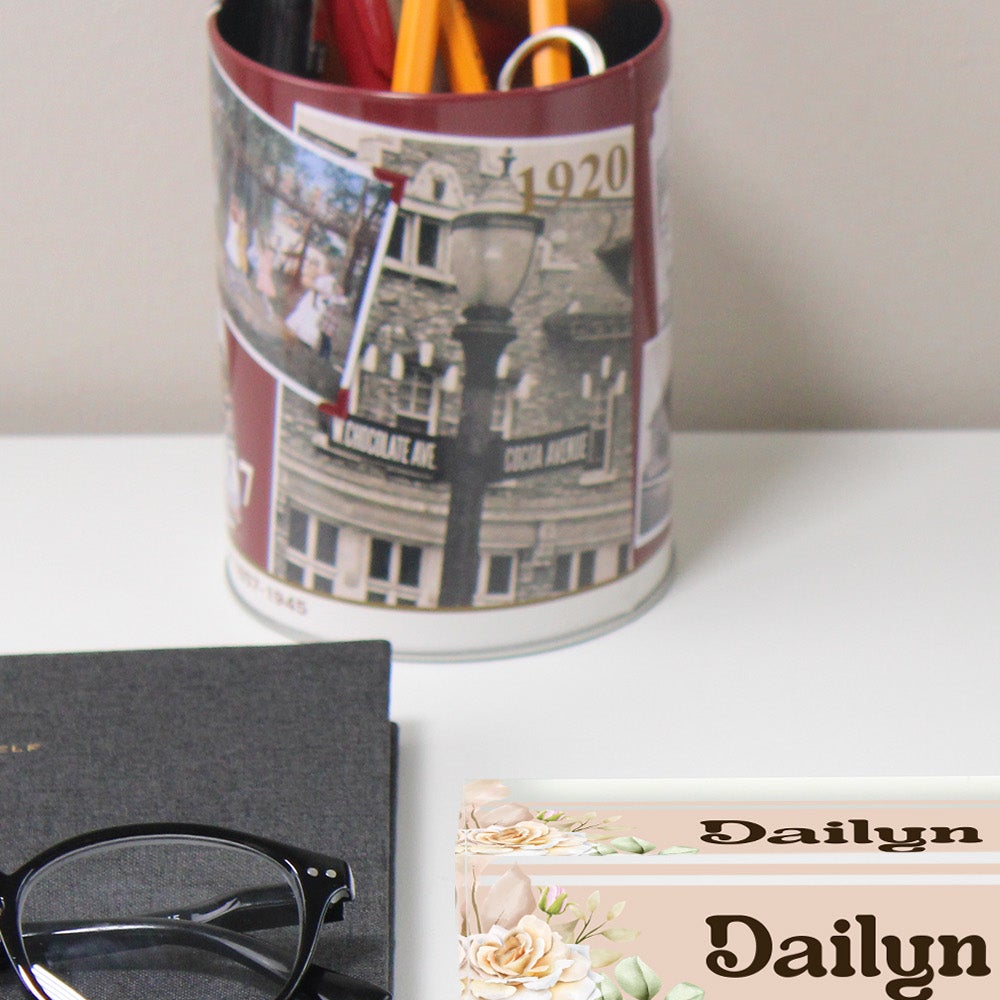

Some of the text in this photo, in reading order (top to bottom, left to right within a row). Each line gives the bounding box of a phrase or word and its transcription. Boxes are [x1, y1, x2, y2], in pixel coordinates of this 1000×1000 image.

[518, 145, 628, 214] 1920
[411, 438, 438, 470] AVE
[701, 819, 982, 853] Dailyn
